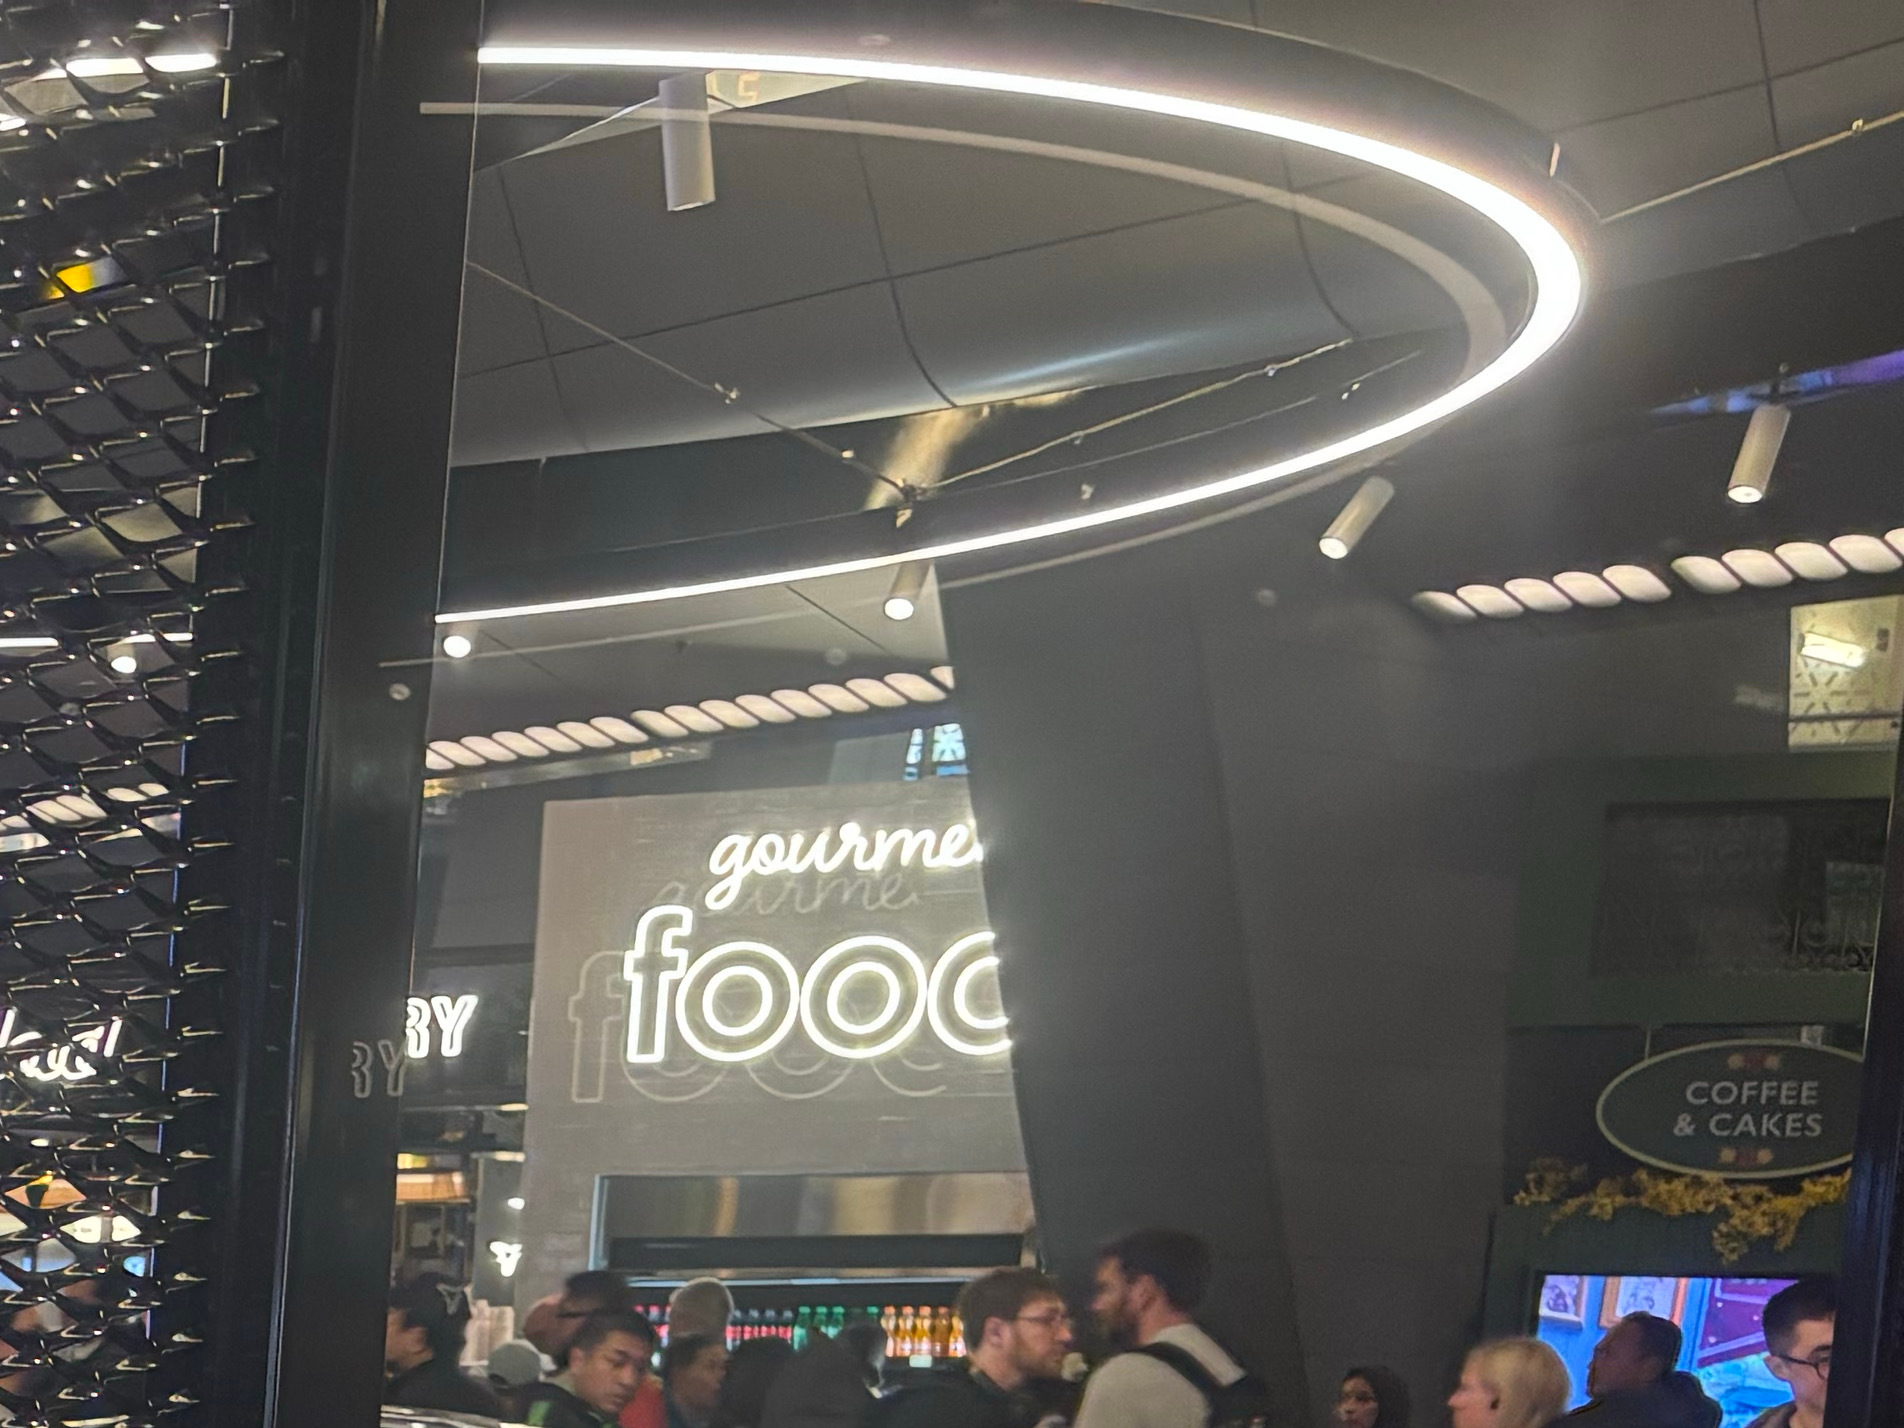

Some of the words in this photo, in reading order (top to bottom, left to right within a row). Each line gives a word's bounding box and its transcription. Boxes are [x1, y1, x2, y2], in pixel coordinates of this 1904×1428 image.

[705, 822, 985, 911] gourme
[1685, 1080, 1820, 1106] COFFEE
[1672, 1112, 1696, 1137] &
[1708, 1112, 1824, 1138] CAKES
